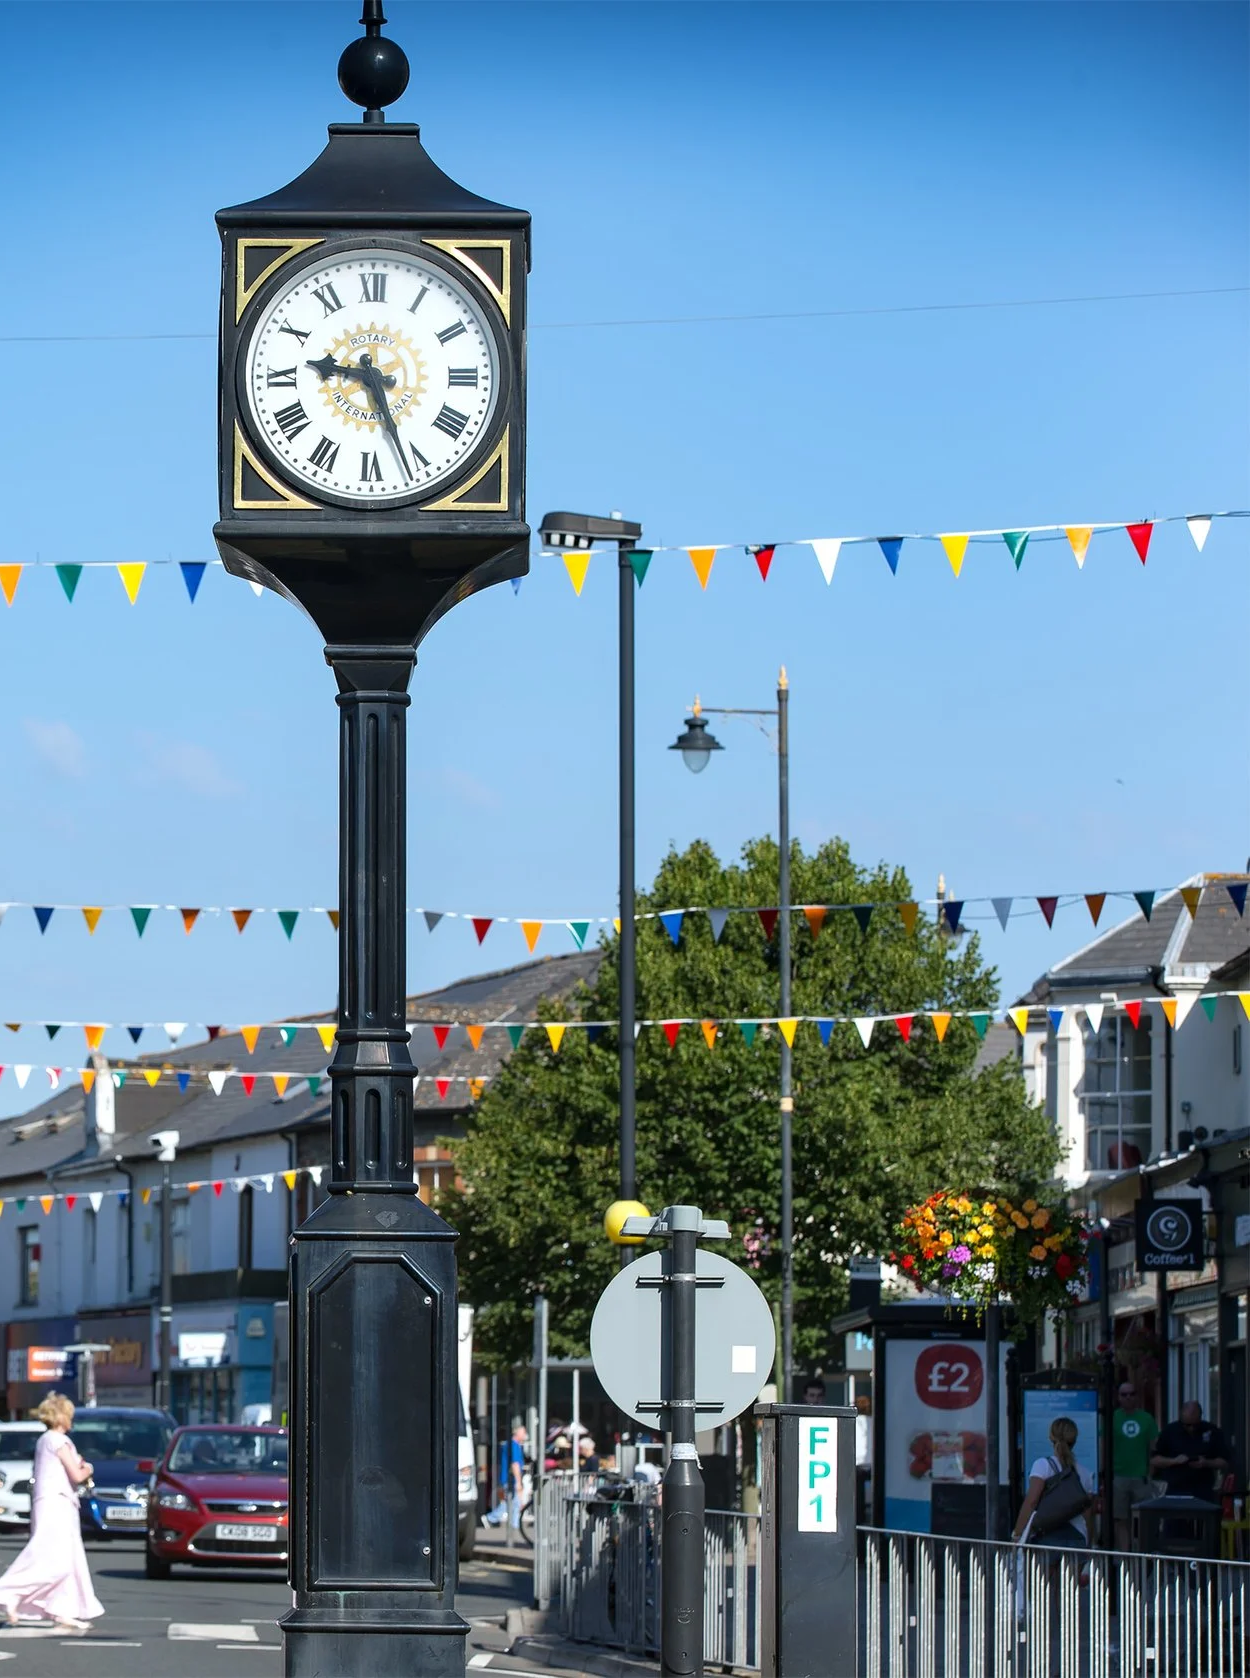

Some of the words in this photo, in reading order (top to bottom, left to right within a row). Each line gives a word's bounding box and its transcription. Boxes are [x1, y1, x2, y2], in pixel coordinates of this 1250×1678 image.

[310, 281, 346, 319] XI
[358, 273, 389, 303] XII
[406, 285, 431, 315] I
[278, 318, 312, 348] X
[350, 334, 395, 347] ROTARY
[434, 318, 468, 347] II
[266, 365, 298, 390] IX
[448, 365, 478, 390] III
[332, 391, 413, 421] INTERNATONAL
[273, 399, 313, 444] VIII
[431, 402, 471, 442] IIII
[307, 435, 341, 474] VII
[358, 450, 384, 482] VI
[409, 440, 432, 473] V
[928, 1361, 970, 1393] £2
